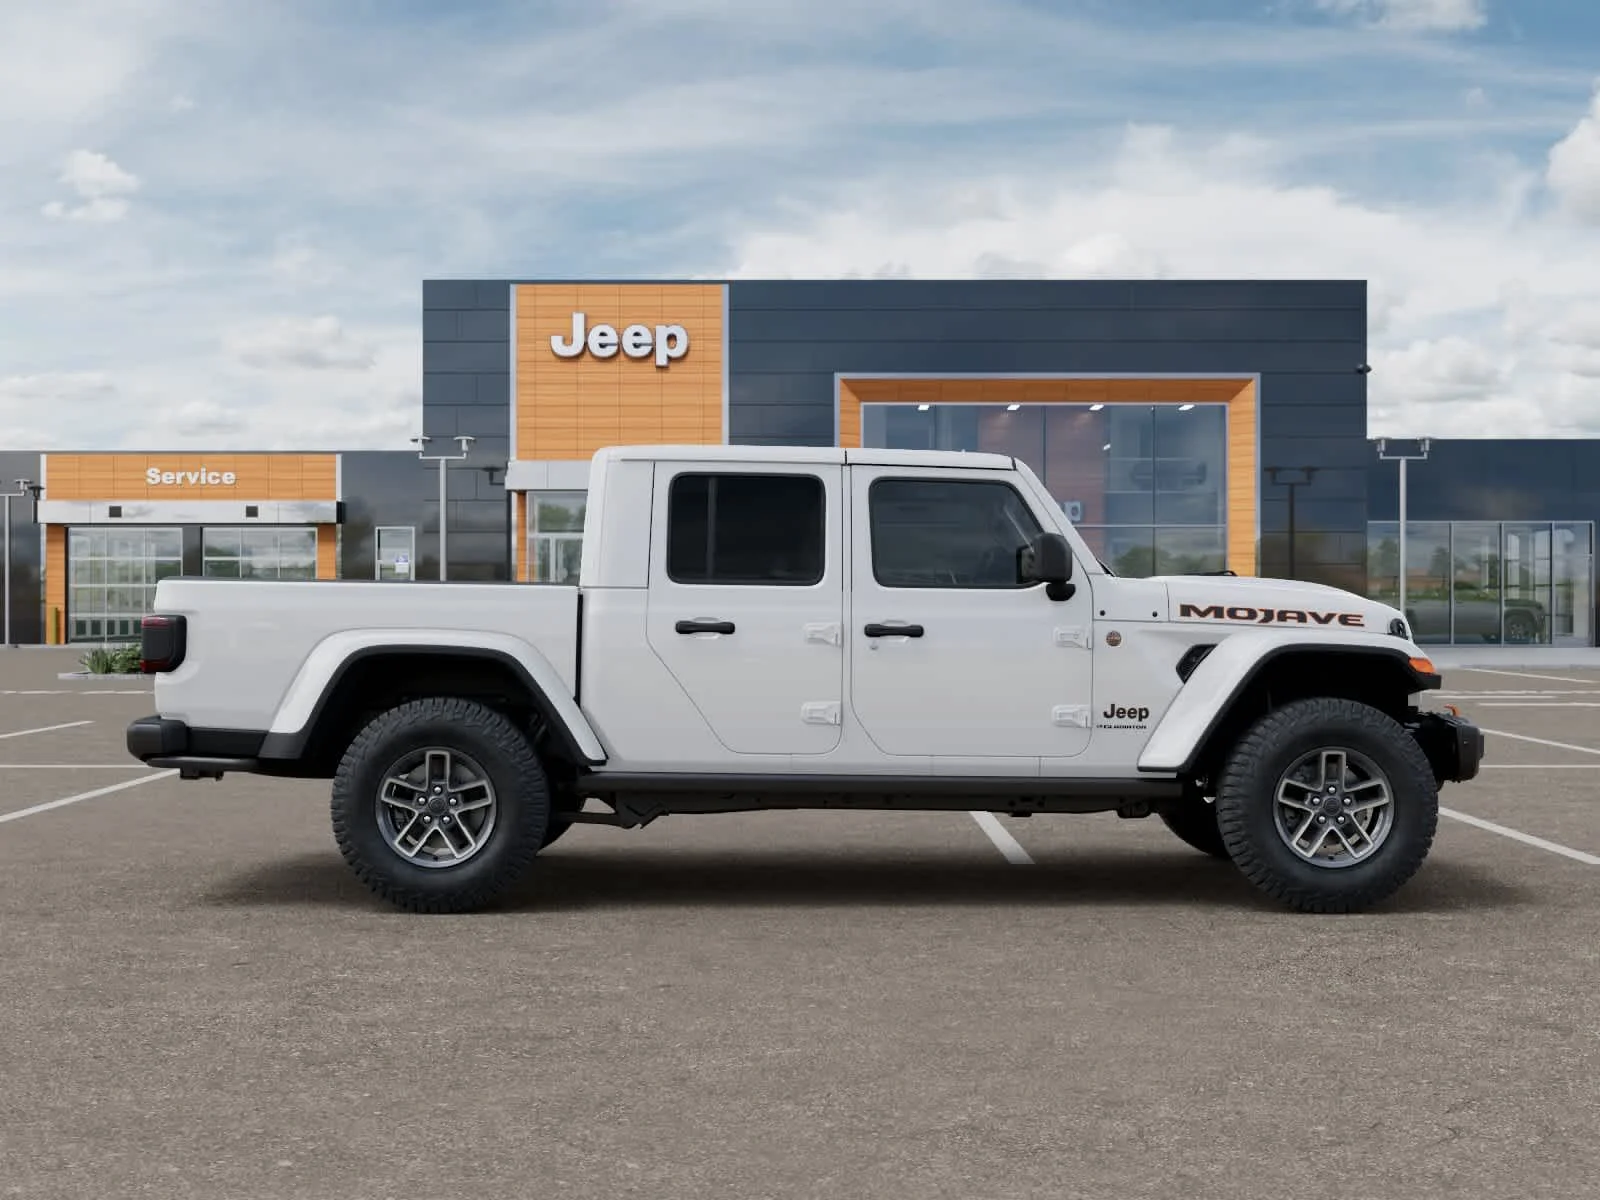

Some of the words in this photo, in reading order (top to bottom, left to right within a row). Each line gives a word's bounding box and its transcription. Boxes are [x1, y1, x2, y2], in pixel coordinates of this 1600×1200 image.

[550, 311, 689, 367] Jeep
[145, 466, 237, 486] Service
[1179, 603, 1365, 627] MOJAVE
[1103, 703, 1150, 722] Jeep
